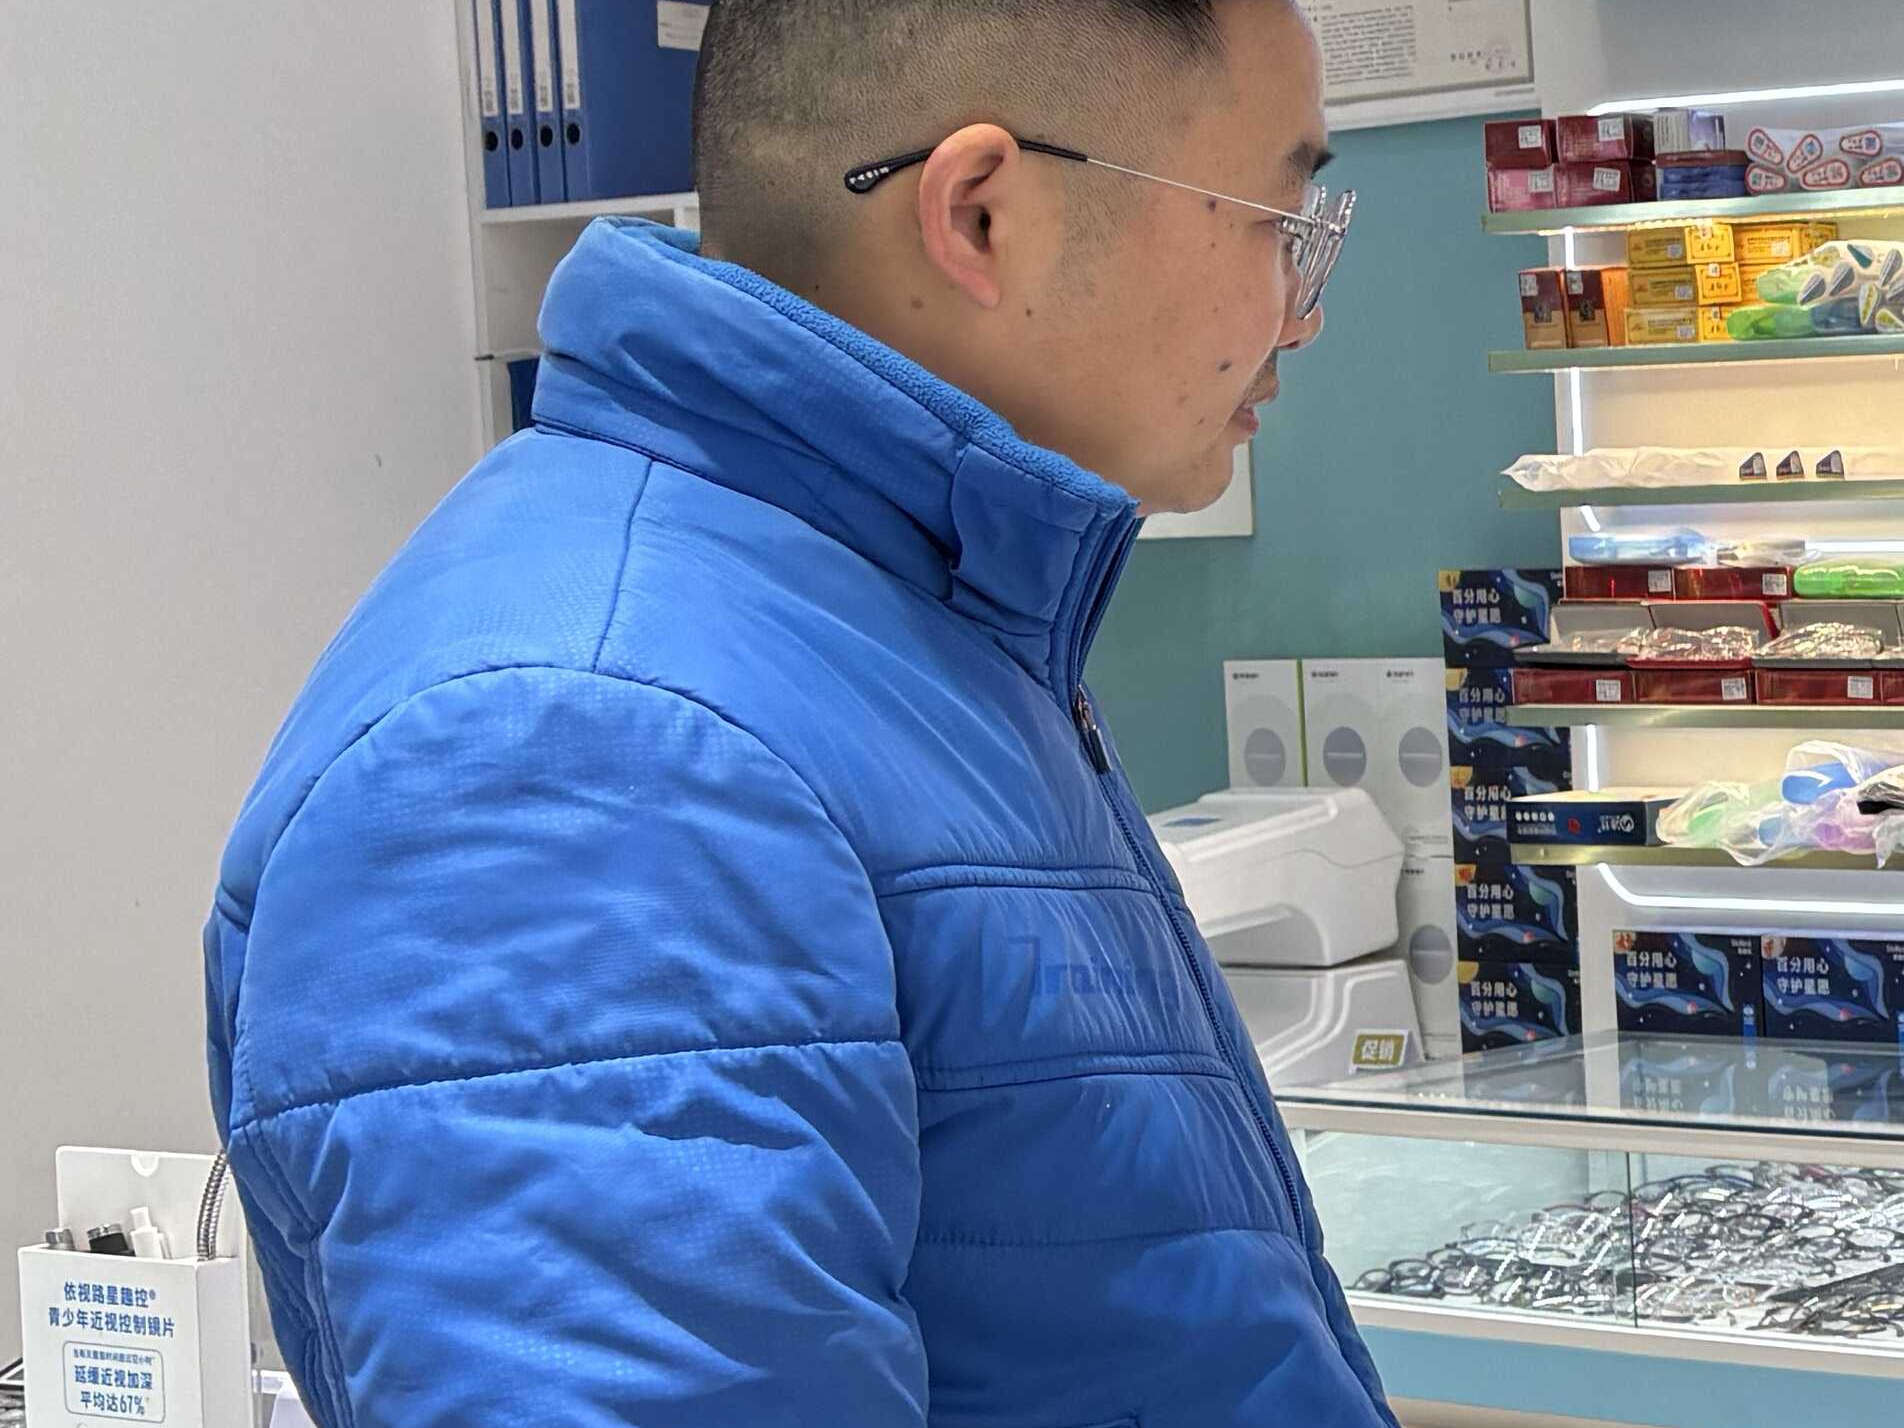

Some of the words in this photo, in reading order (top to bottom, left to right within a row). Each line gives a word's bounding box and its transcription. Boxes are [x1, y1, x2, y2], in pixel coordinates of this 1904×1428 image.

[1452, 588, 1501, 605] 百分用心
[1458, 686, 1506, 703] 百分用心
[1464, 785, 1512, 802] 百分用心
[1466, 883, 1514, 901] 百分用心
[1626, 950, 1678, 970] 百分用心
[1776, 955, 1830, 975] 百分用心
[1470, 980, 1518, 999] 百分用心
[1626, 970, 1678, 991] 守护星愿
[1776, 976, 1831, 997] 守护星愿
[48, 1306, 176, 1339] 青少年近视控制镜片
[74, 1364, 153, 1390] 延缓近视加深
